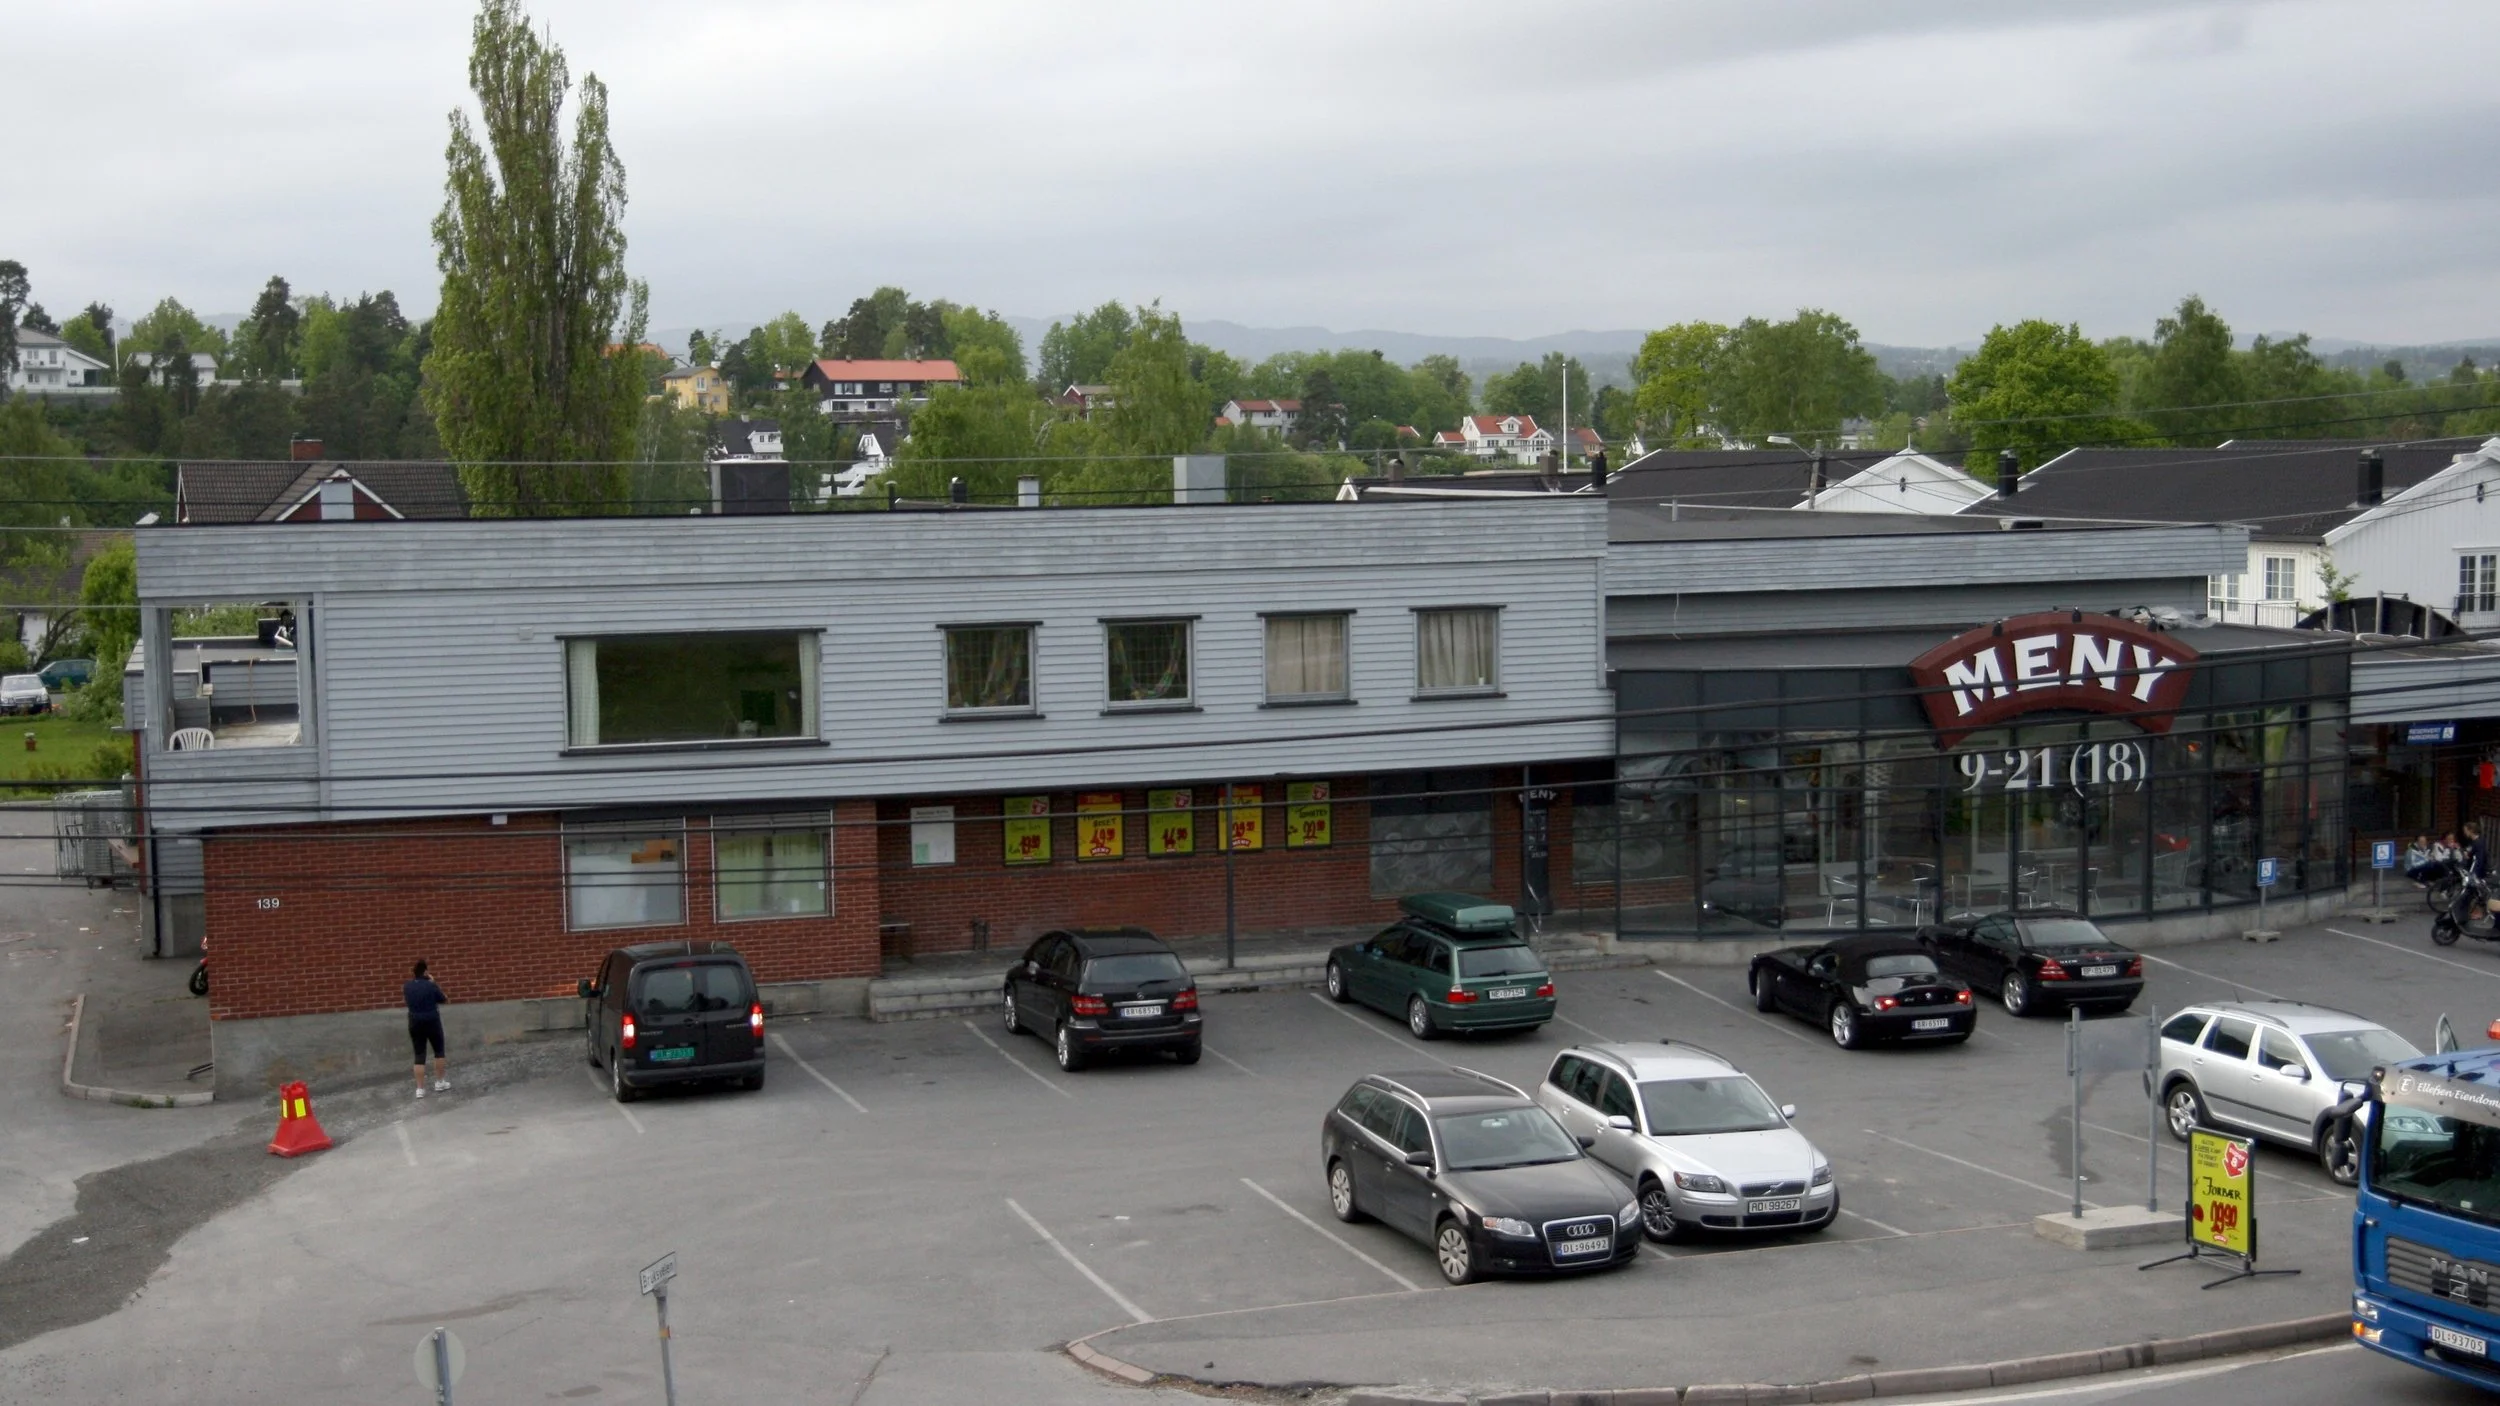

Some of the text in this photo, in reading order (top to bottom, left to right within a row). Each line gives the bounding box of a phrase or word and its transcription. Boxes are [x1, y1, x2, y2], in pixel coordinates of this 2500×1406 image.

[1943, 634, 2177, 717] MENY
[1960, 742, 2146, 797] 9-21 (18)
[256, 897, 280, 909] 139
[2430, 1257, 2488, 1285] MAN
